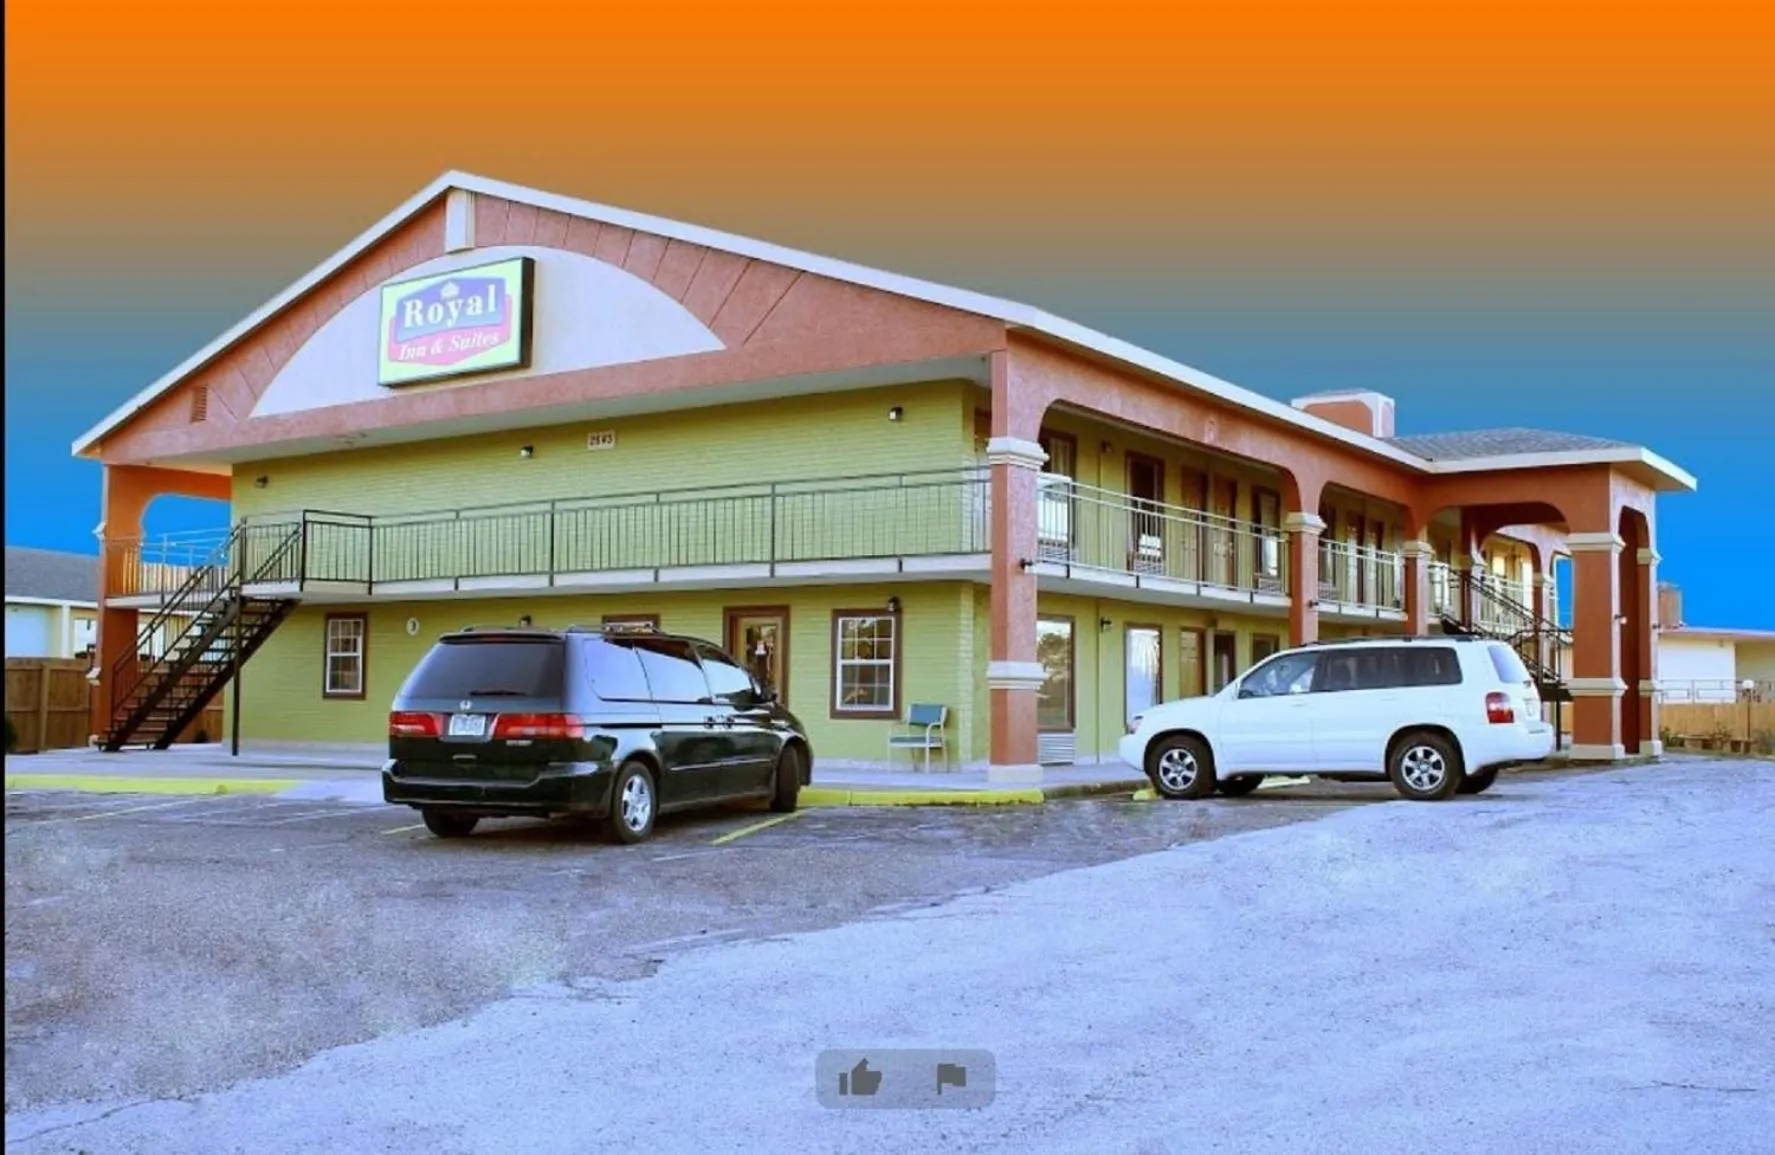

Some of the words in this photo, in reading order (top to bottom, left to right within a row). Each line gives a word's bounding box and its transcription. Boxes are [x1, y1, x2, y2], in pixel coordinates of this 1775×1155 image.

[403, 283, 496, 329] Royal
[399, 344, 426, 361] Inn
[430, 338, 444, 355] &
[448, 330, 500, 353] Suites
